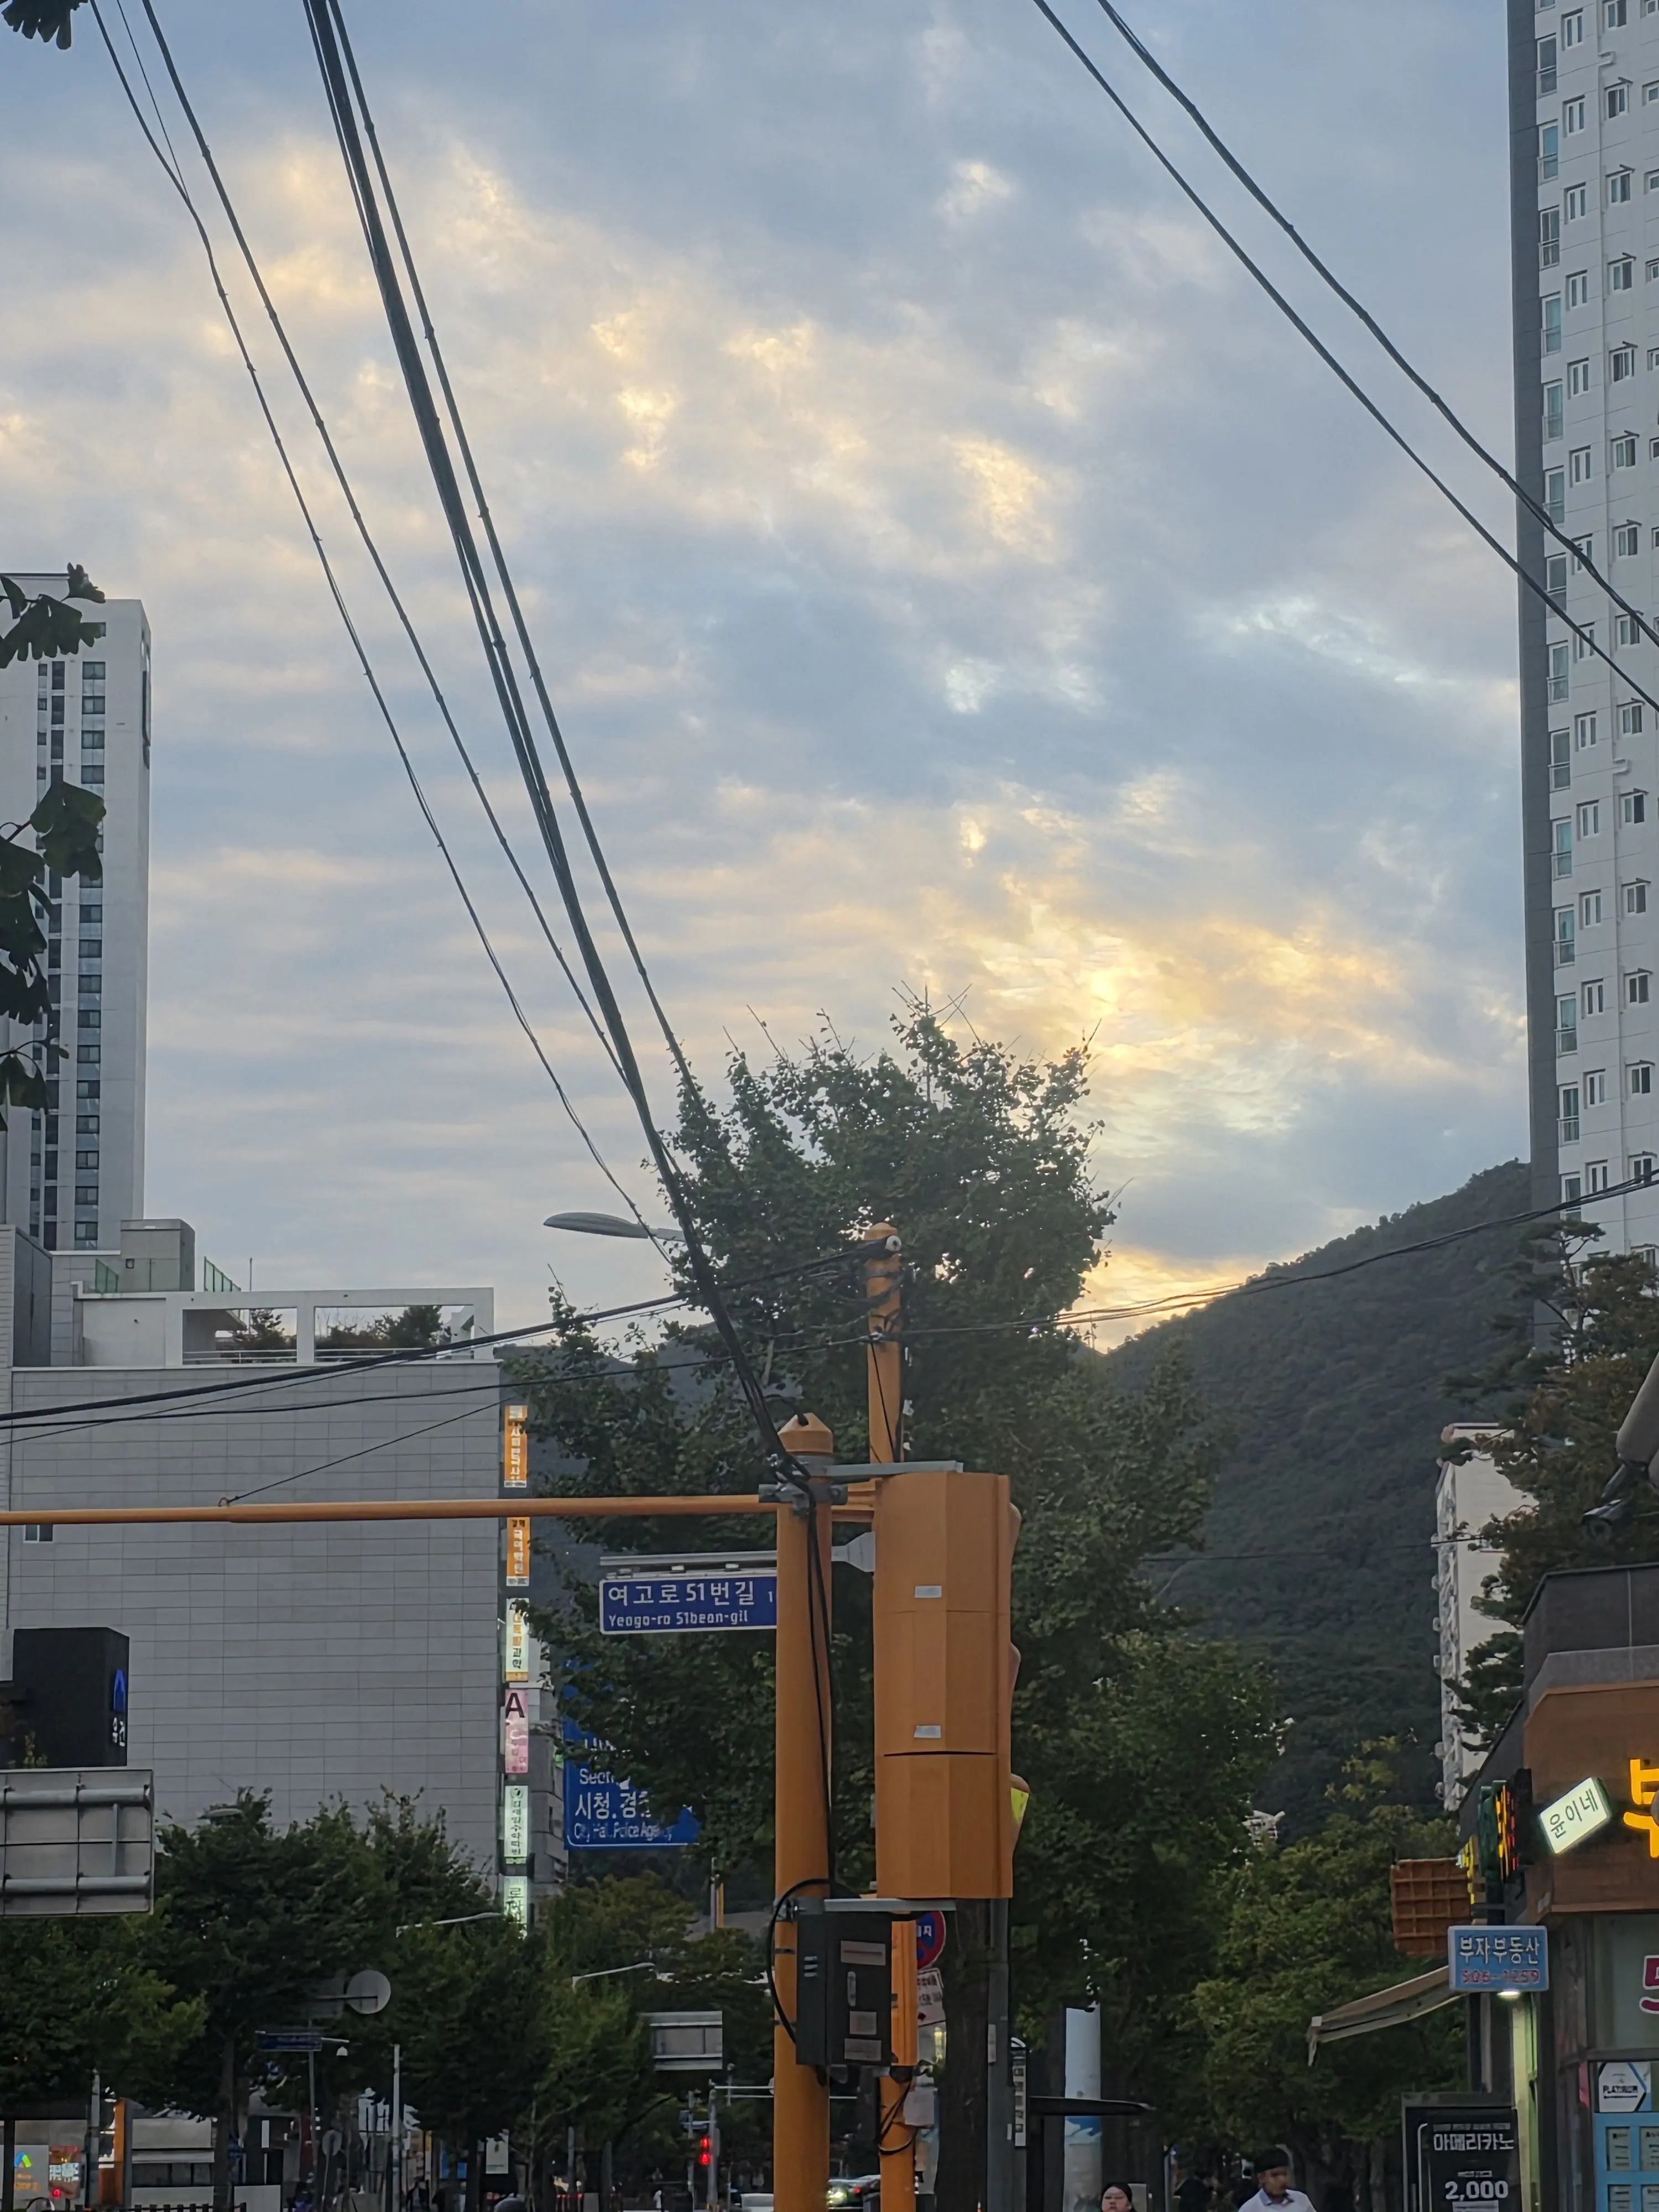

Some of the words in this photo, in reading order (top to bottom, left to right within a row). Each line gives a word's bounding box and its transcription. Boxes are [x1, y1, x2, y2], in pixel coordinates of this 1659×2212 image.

[609, 1613, 671, 1628] Yeogo-ro
[676, 1610, 748, 1625] 51beon-gil
[1550, 1788, 1599, 1839] 윤이네
[1460, 1937, 1540, 1964] 부자부동산
[1434, 2133, 1514, 2151] 아메리카노
[1445, 2180, 1509, 2201] 2,000
